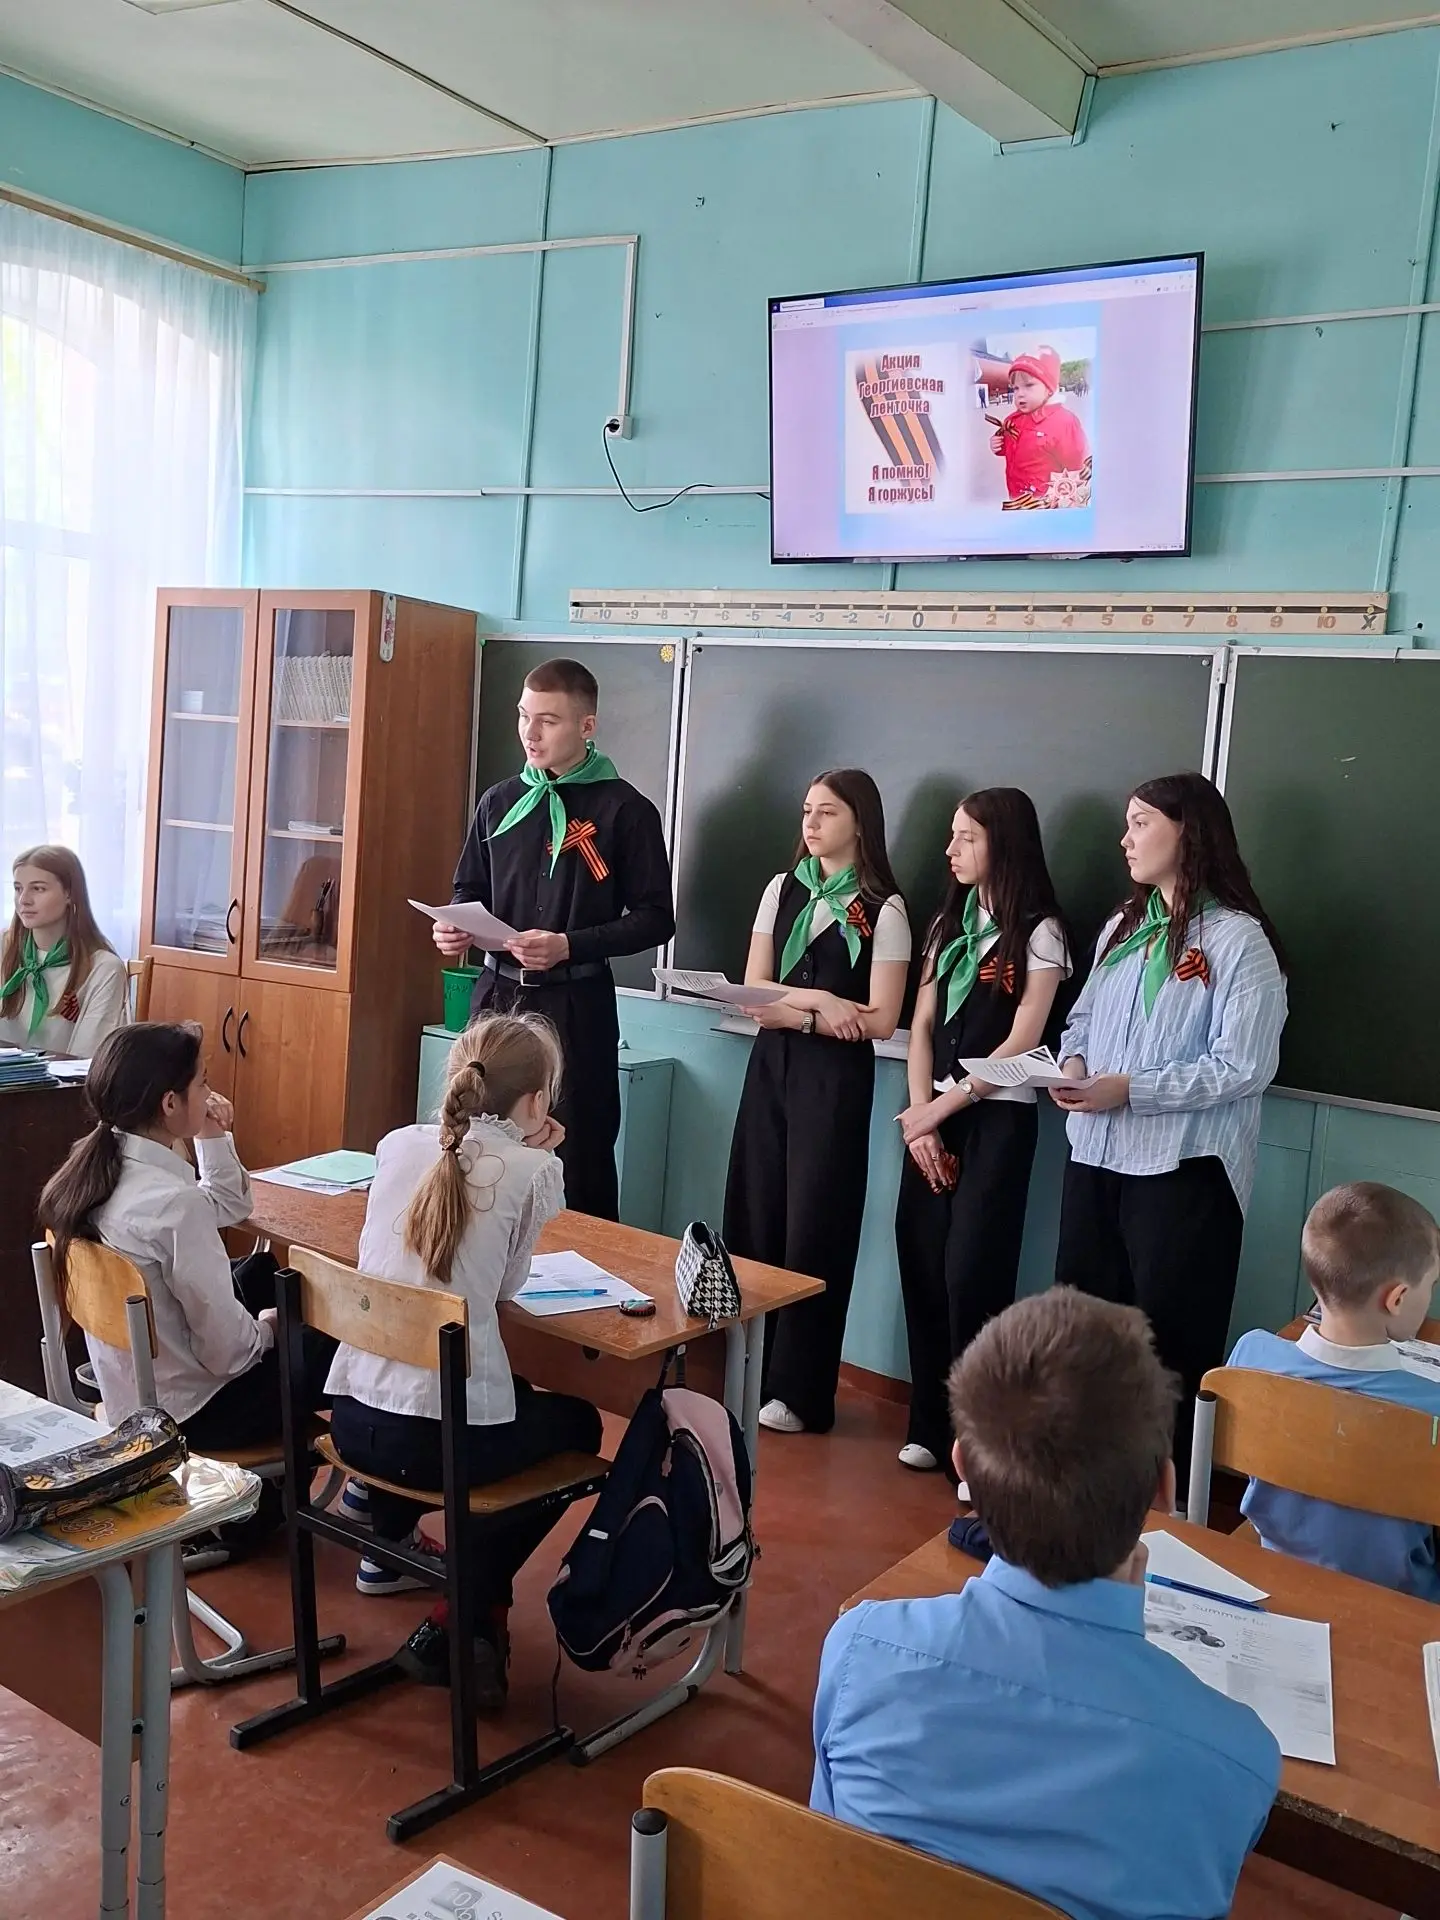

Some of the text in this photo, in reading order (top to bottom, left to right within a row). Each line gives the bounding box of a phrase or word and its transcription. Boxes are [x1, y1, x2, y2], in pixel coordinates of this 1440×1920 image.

[881, 354, 920, 370] Акция
[859, 377, 944, 399] Георгиевская
[870, 399, 930, 417] ленточка
[872, 463, 929, 481] Я помню!
[868, 484, 934, 503] Я горжусь!
[593, 609, 612, 620] -10
[625, 610, 639, 620] -9
[656, 610, 669, 620] -8
[684, 610, 698, 623] -7
[715, 610, 730, 621] -6
[745, 611, 760, 622] -5
[775, 611, 792, 622] -4
[808, 611, 825, 623] -3
[842, 612, 858, 624] -2
[877, 612, 890, 624] -1
[912, 612, 924, 628] 0
[951, 613, 958, 625] 1
[986, 613, 997, 625] 2
[1024, 613, 1035, 626] 3
[1061, 613, 1074, 627] 4
[1101, 613, 1115, 626] 5
[1141, 614, 1154, 627] 6
[1183, 614, 1195, 628] 7
[1225, 614, 1238, 628] 8
[1270, 615, 1283, 628] 9
[1317, 615, 1336, 629] 10
[1193, 1603, 1248, 1622] Summer
